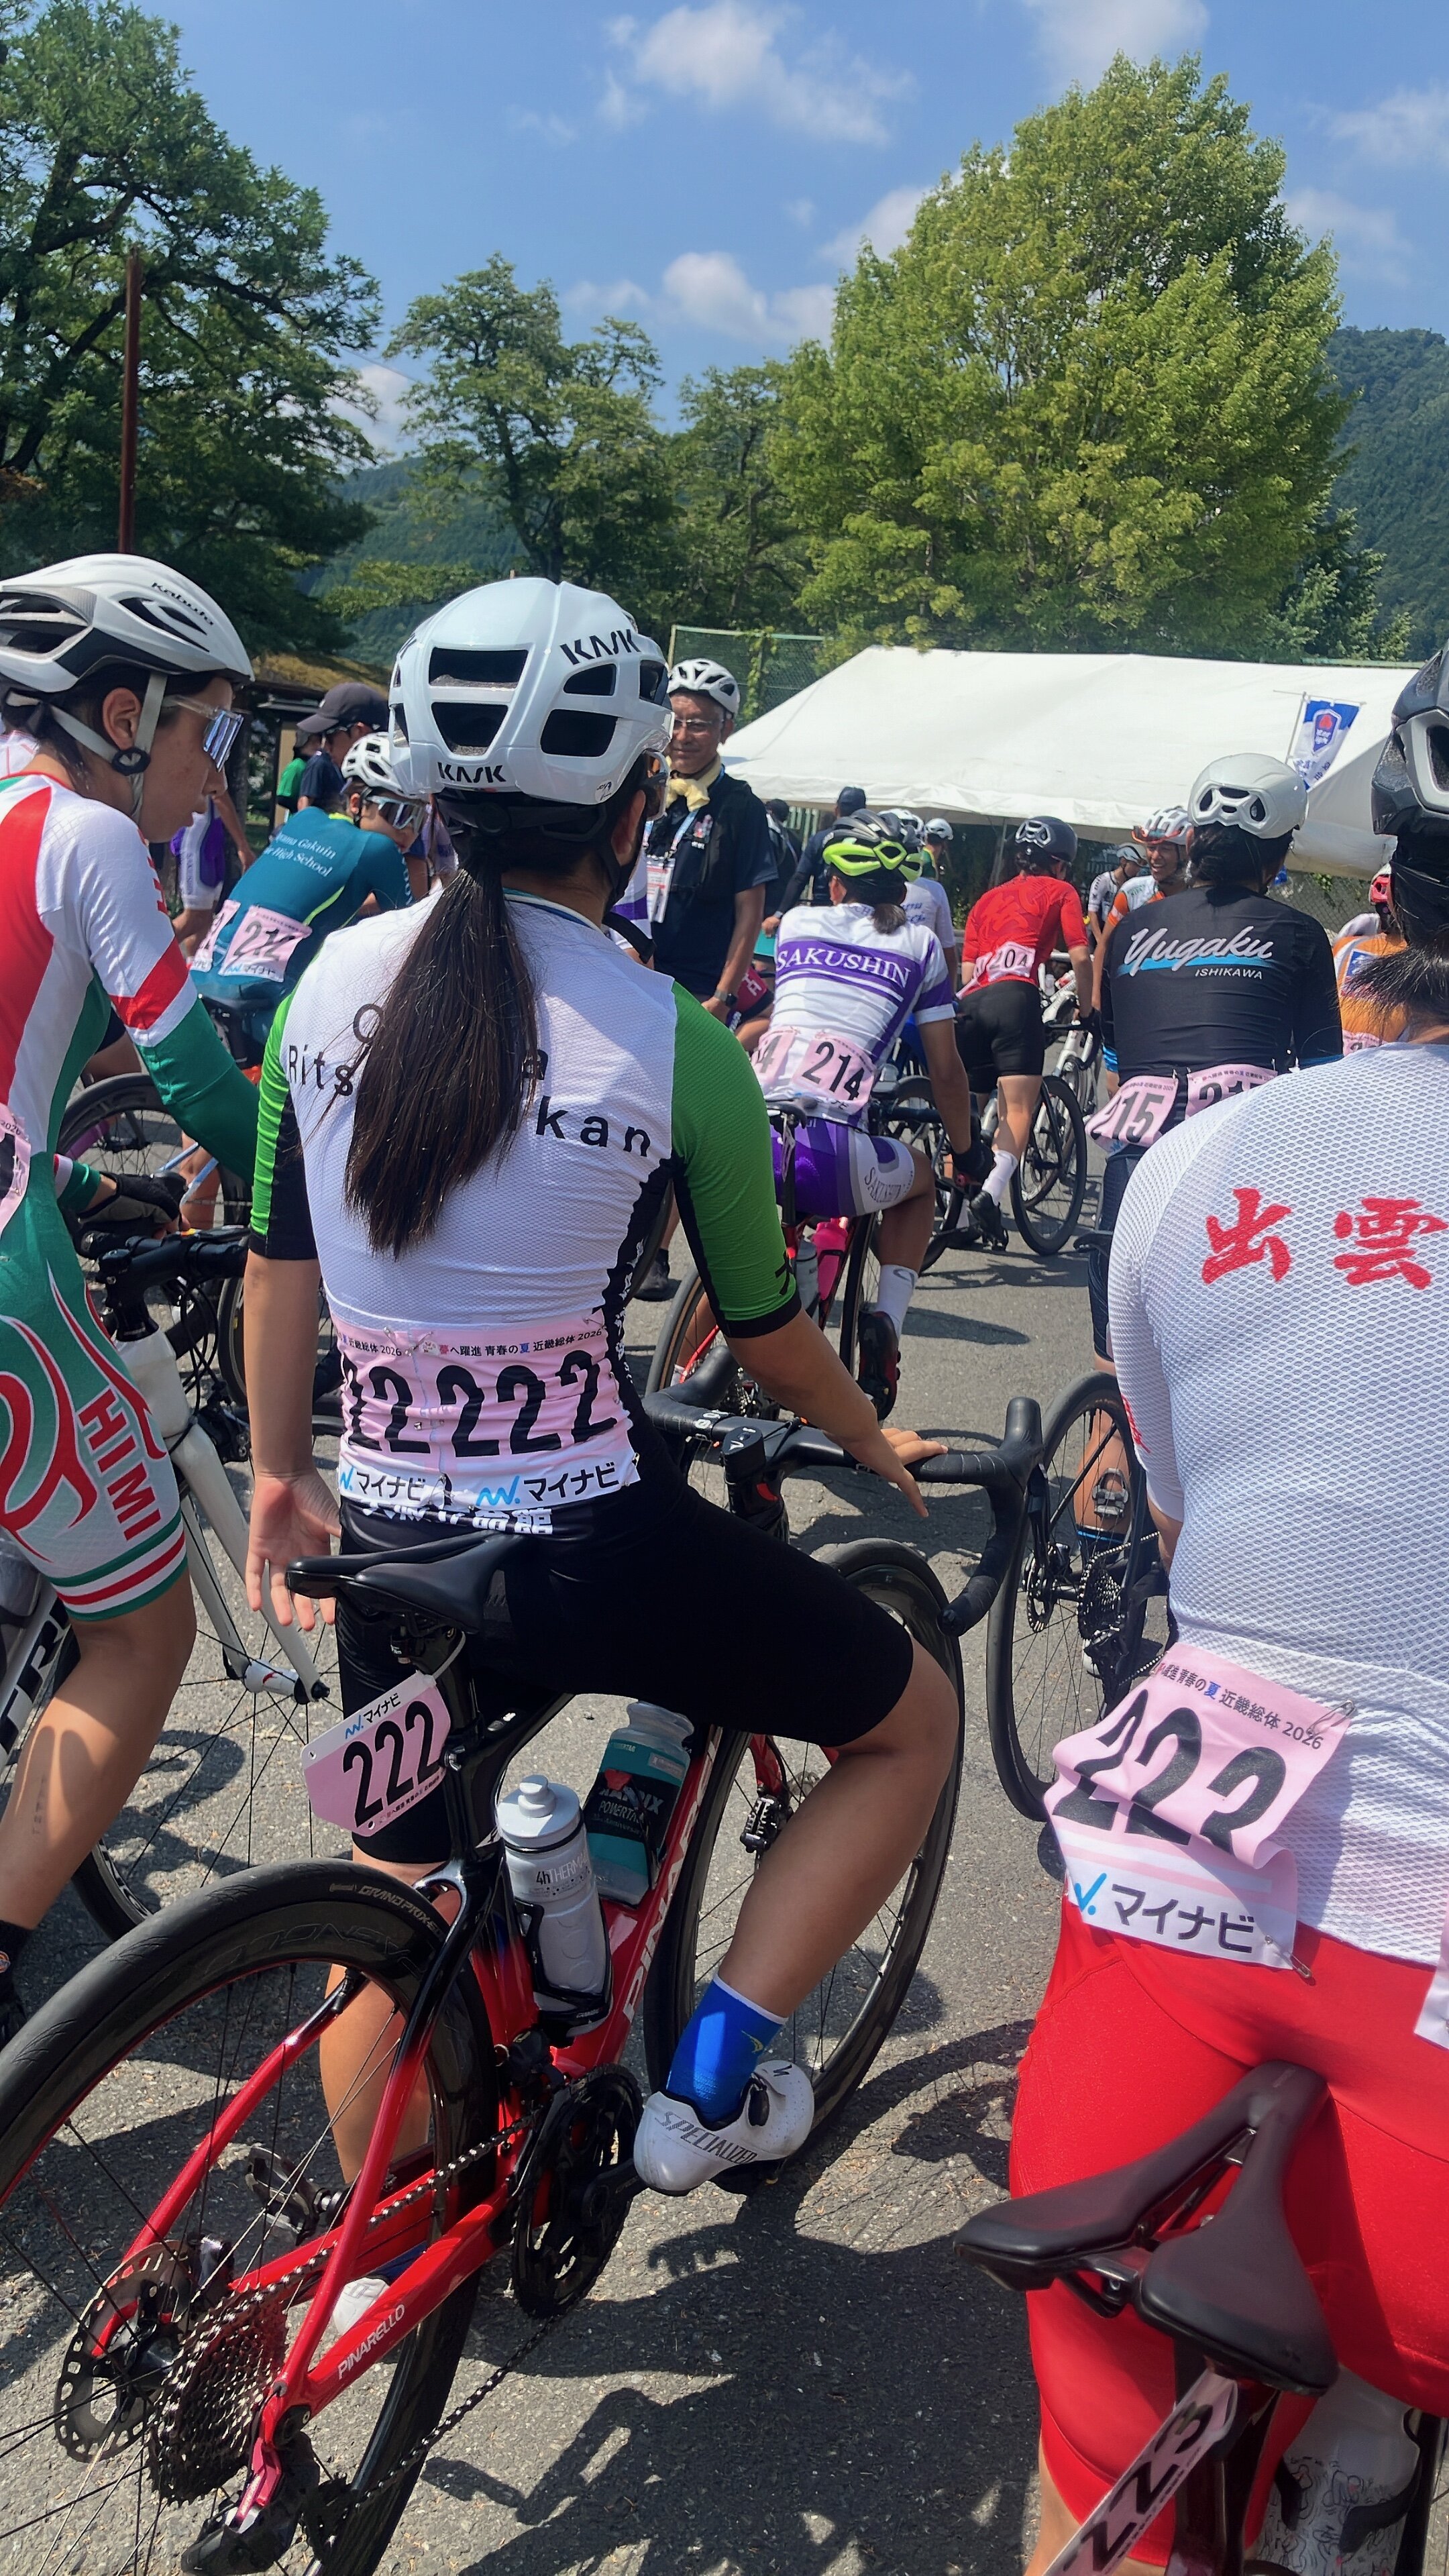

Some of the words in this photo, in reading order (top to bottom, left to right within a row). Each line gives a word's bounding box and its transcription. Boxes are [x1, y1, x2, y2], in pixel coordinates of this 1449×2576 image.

[559, 629, 642, 665] KASK
[437, 761, 507, 784] KASK
[294, 853, 333, 877] School
[776, 947, 912, 989] SAKUSHIN
[1124, 926, 1274, 977] Yugaku
[1195, 968, 1263, 979] ISHIKAWA
[802, 1041, 865, 1101] 214
[1201, 1187, 1449, 1289] 出雲
[380, 1344, 402, 1356] 2026
[484, 1342, 531, 1356] 青春の夏
[533, 1334, 576, 1352] 近畿総体
[578, 1328, 602, 1342] 2026
[436, 1349, 617, 1458] 222
[78, 1388, 162, 1542] HIMI
[356, 1471, 427, 1503] マイナビ
[523, 1462, 620, 1502] マイナビ
[363, 1693, 401, 1723] マイナビ
[1218, 1688, 1281, 1731] 近畿総体
[1282, 1721, 1324, 1751] 2026
[342, 1701, 440, 1828] 222
[1111, 1882, 1258, 1955] マイナビ
[655, 2111, 758, 2164] SPECIALIZED
[337, 2304, 405, 2380] PINARELLO
